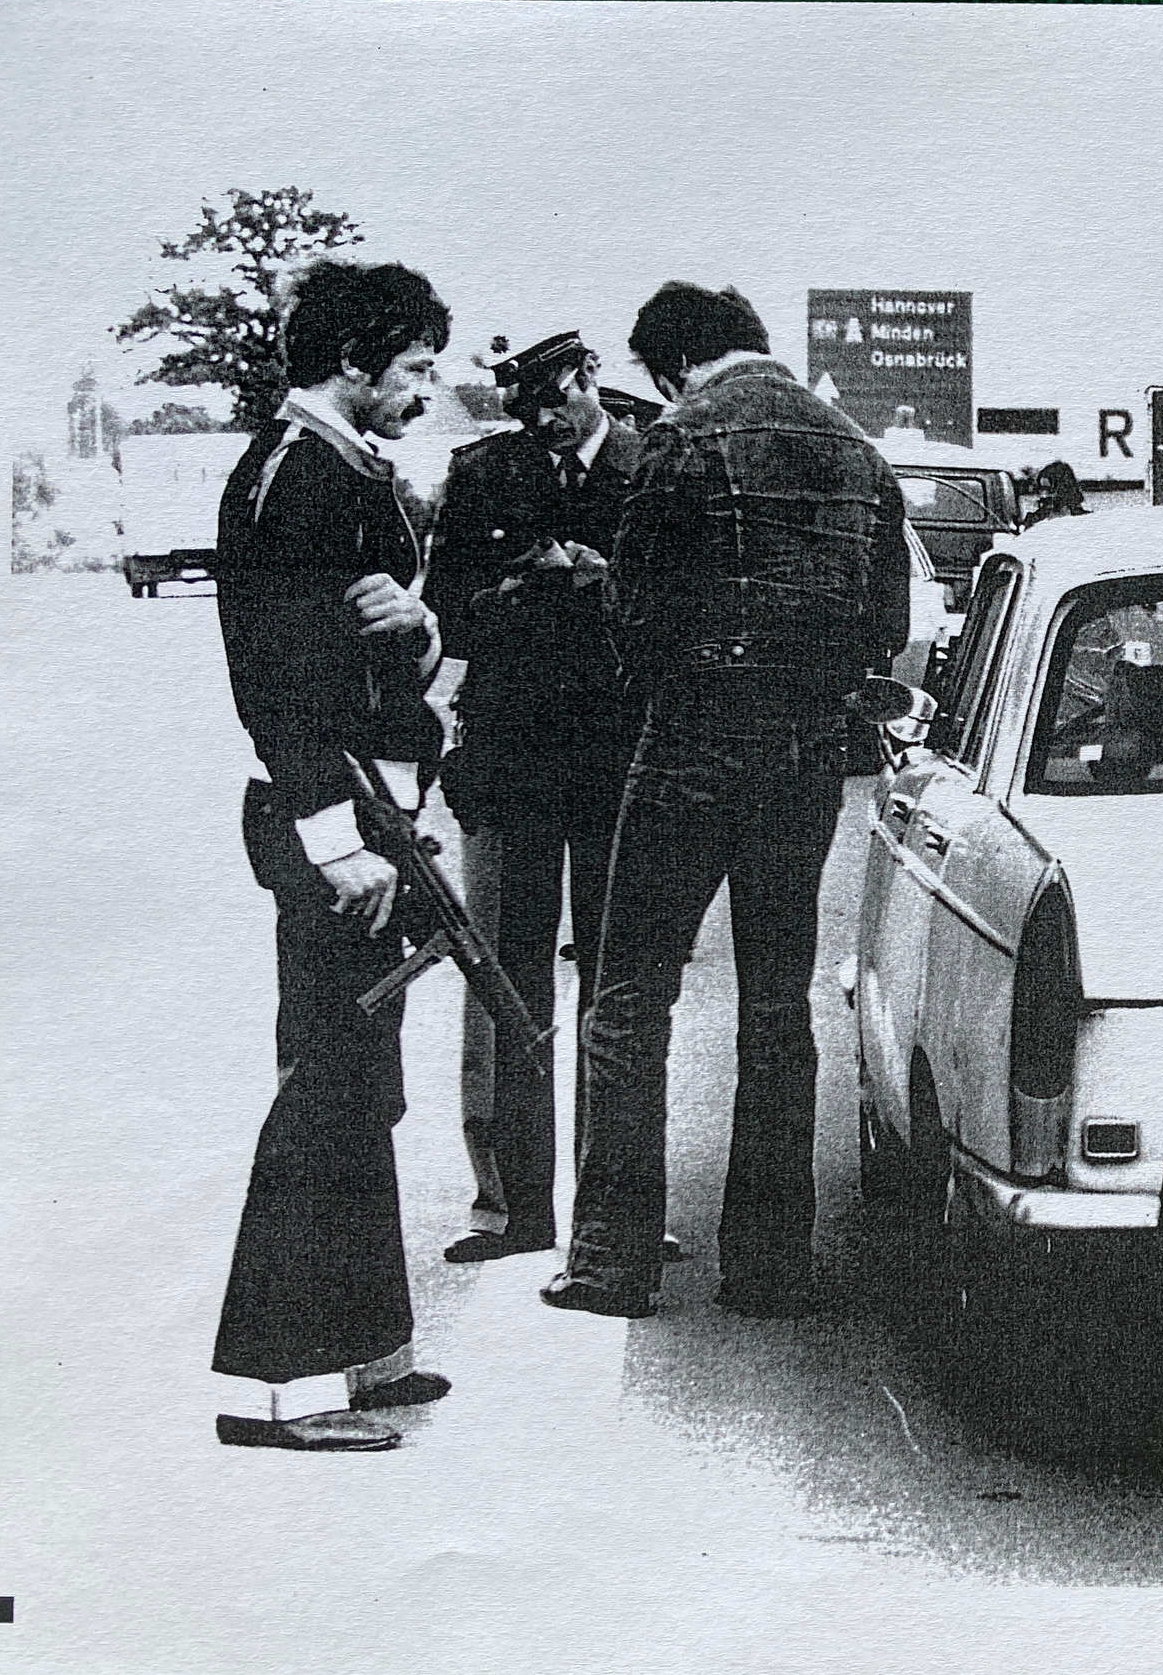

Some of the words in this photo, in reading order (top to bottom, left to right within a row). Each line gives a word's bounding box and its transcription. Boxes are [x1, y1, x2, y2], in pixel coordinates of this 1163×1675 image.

[871, 295, 956, 314] Hannover
[870, 322, 934, 340] Minden
[871, 350, 967, 368] Osnabrück
